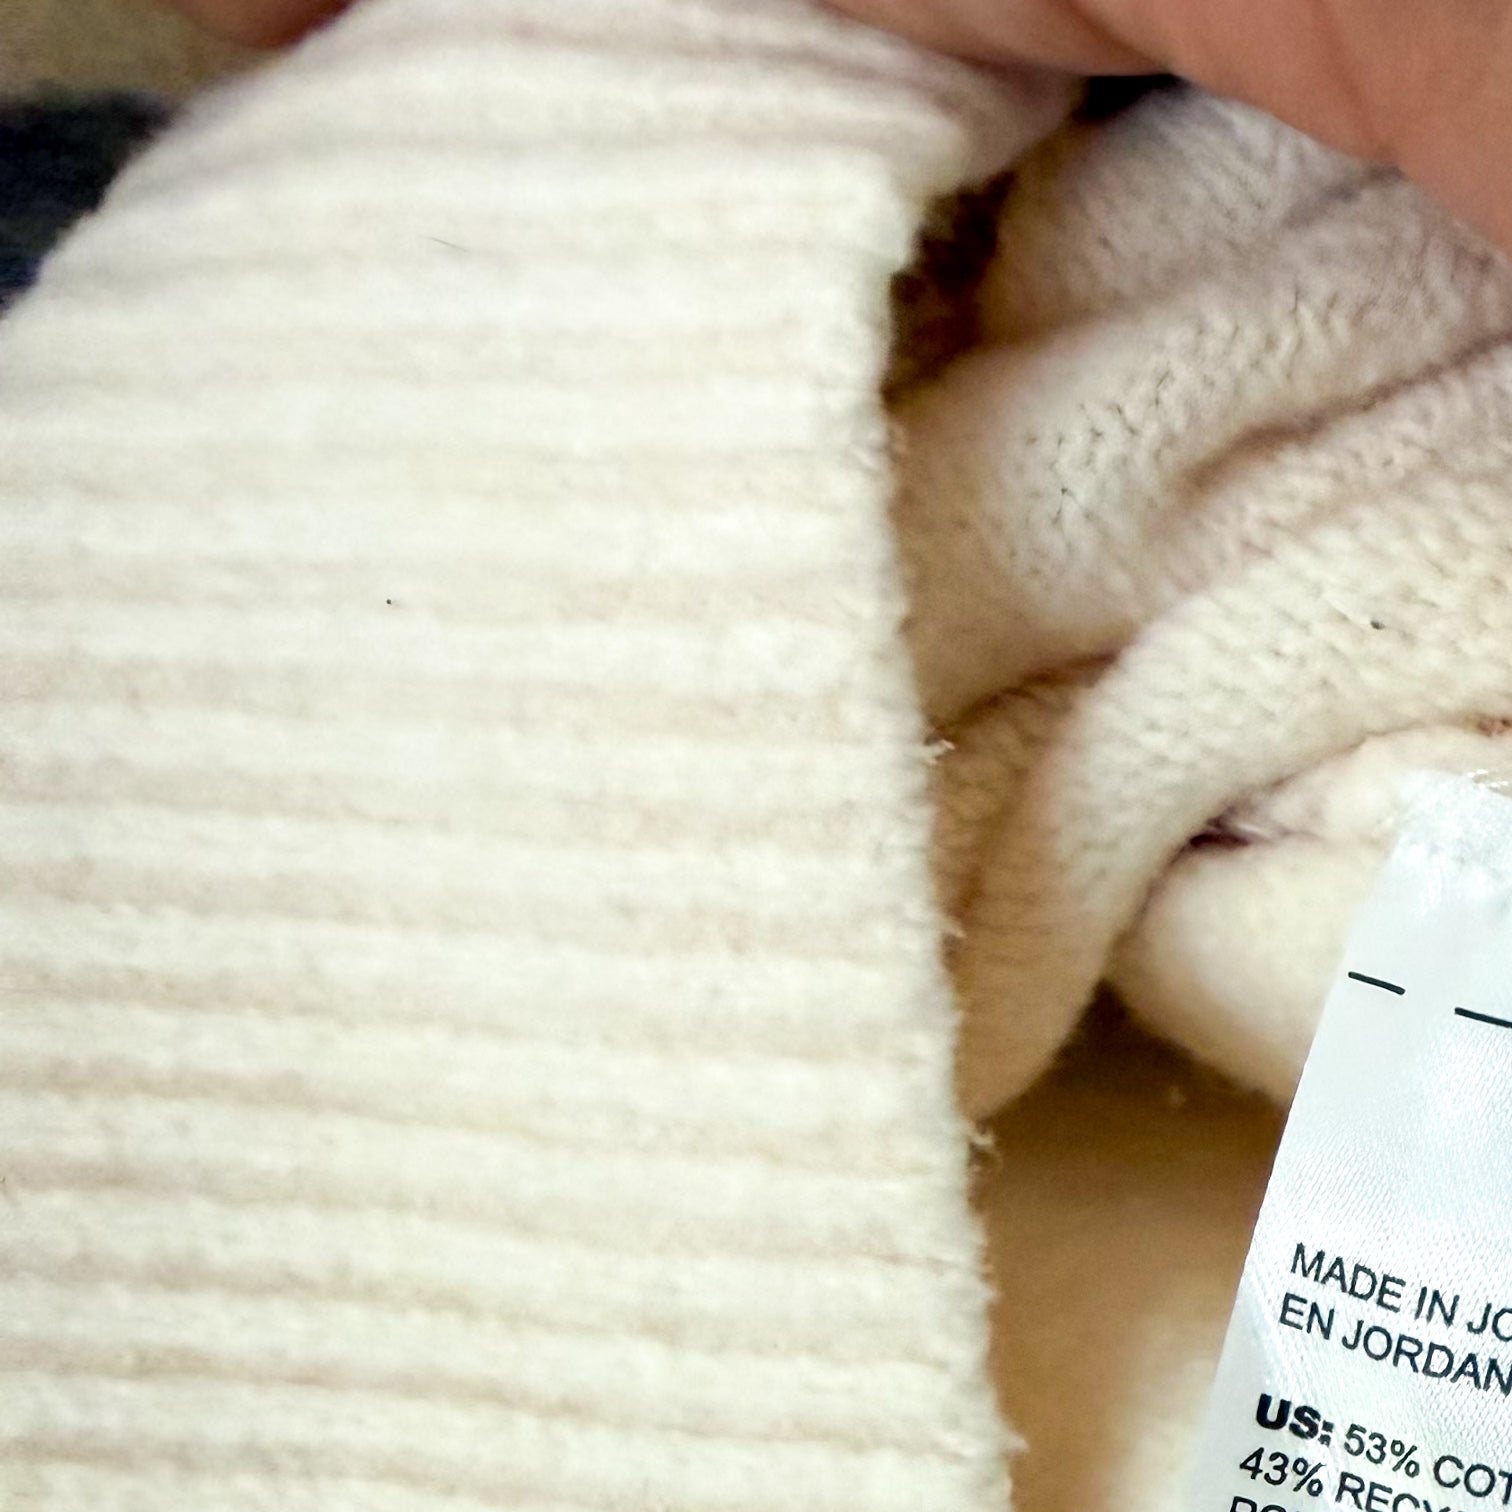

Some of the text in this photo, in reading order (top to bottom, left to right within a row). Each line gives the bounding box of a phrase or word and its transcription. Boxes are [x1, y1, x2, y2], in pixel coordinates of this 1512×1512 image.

[1279, 1292, 1335, 1341] EN
[1290, 1241, 1407, 1314] MADE
[1414, 1286, 1460, 1328] IN
[1255, 1393, 1335, 1448] US:
[1343, 1423, 1420, 1479] 53%
[1239, 1446, 1326, 1498] 43%
